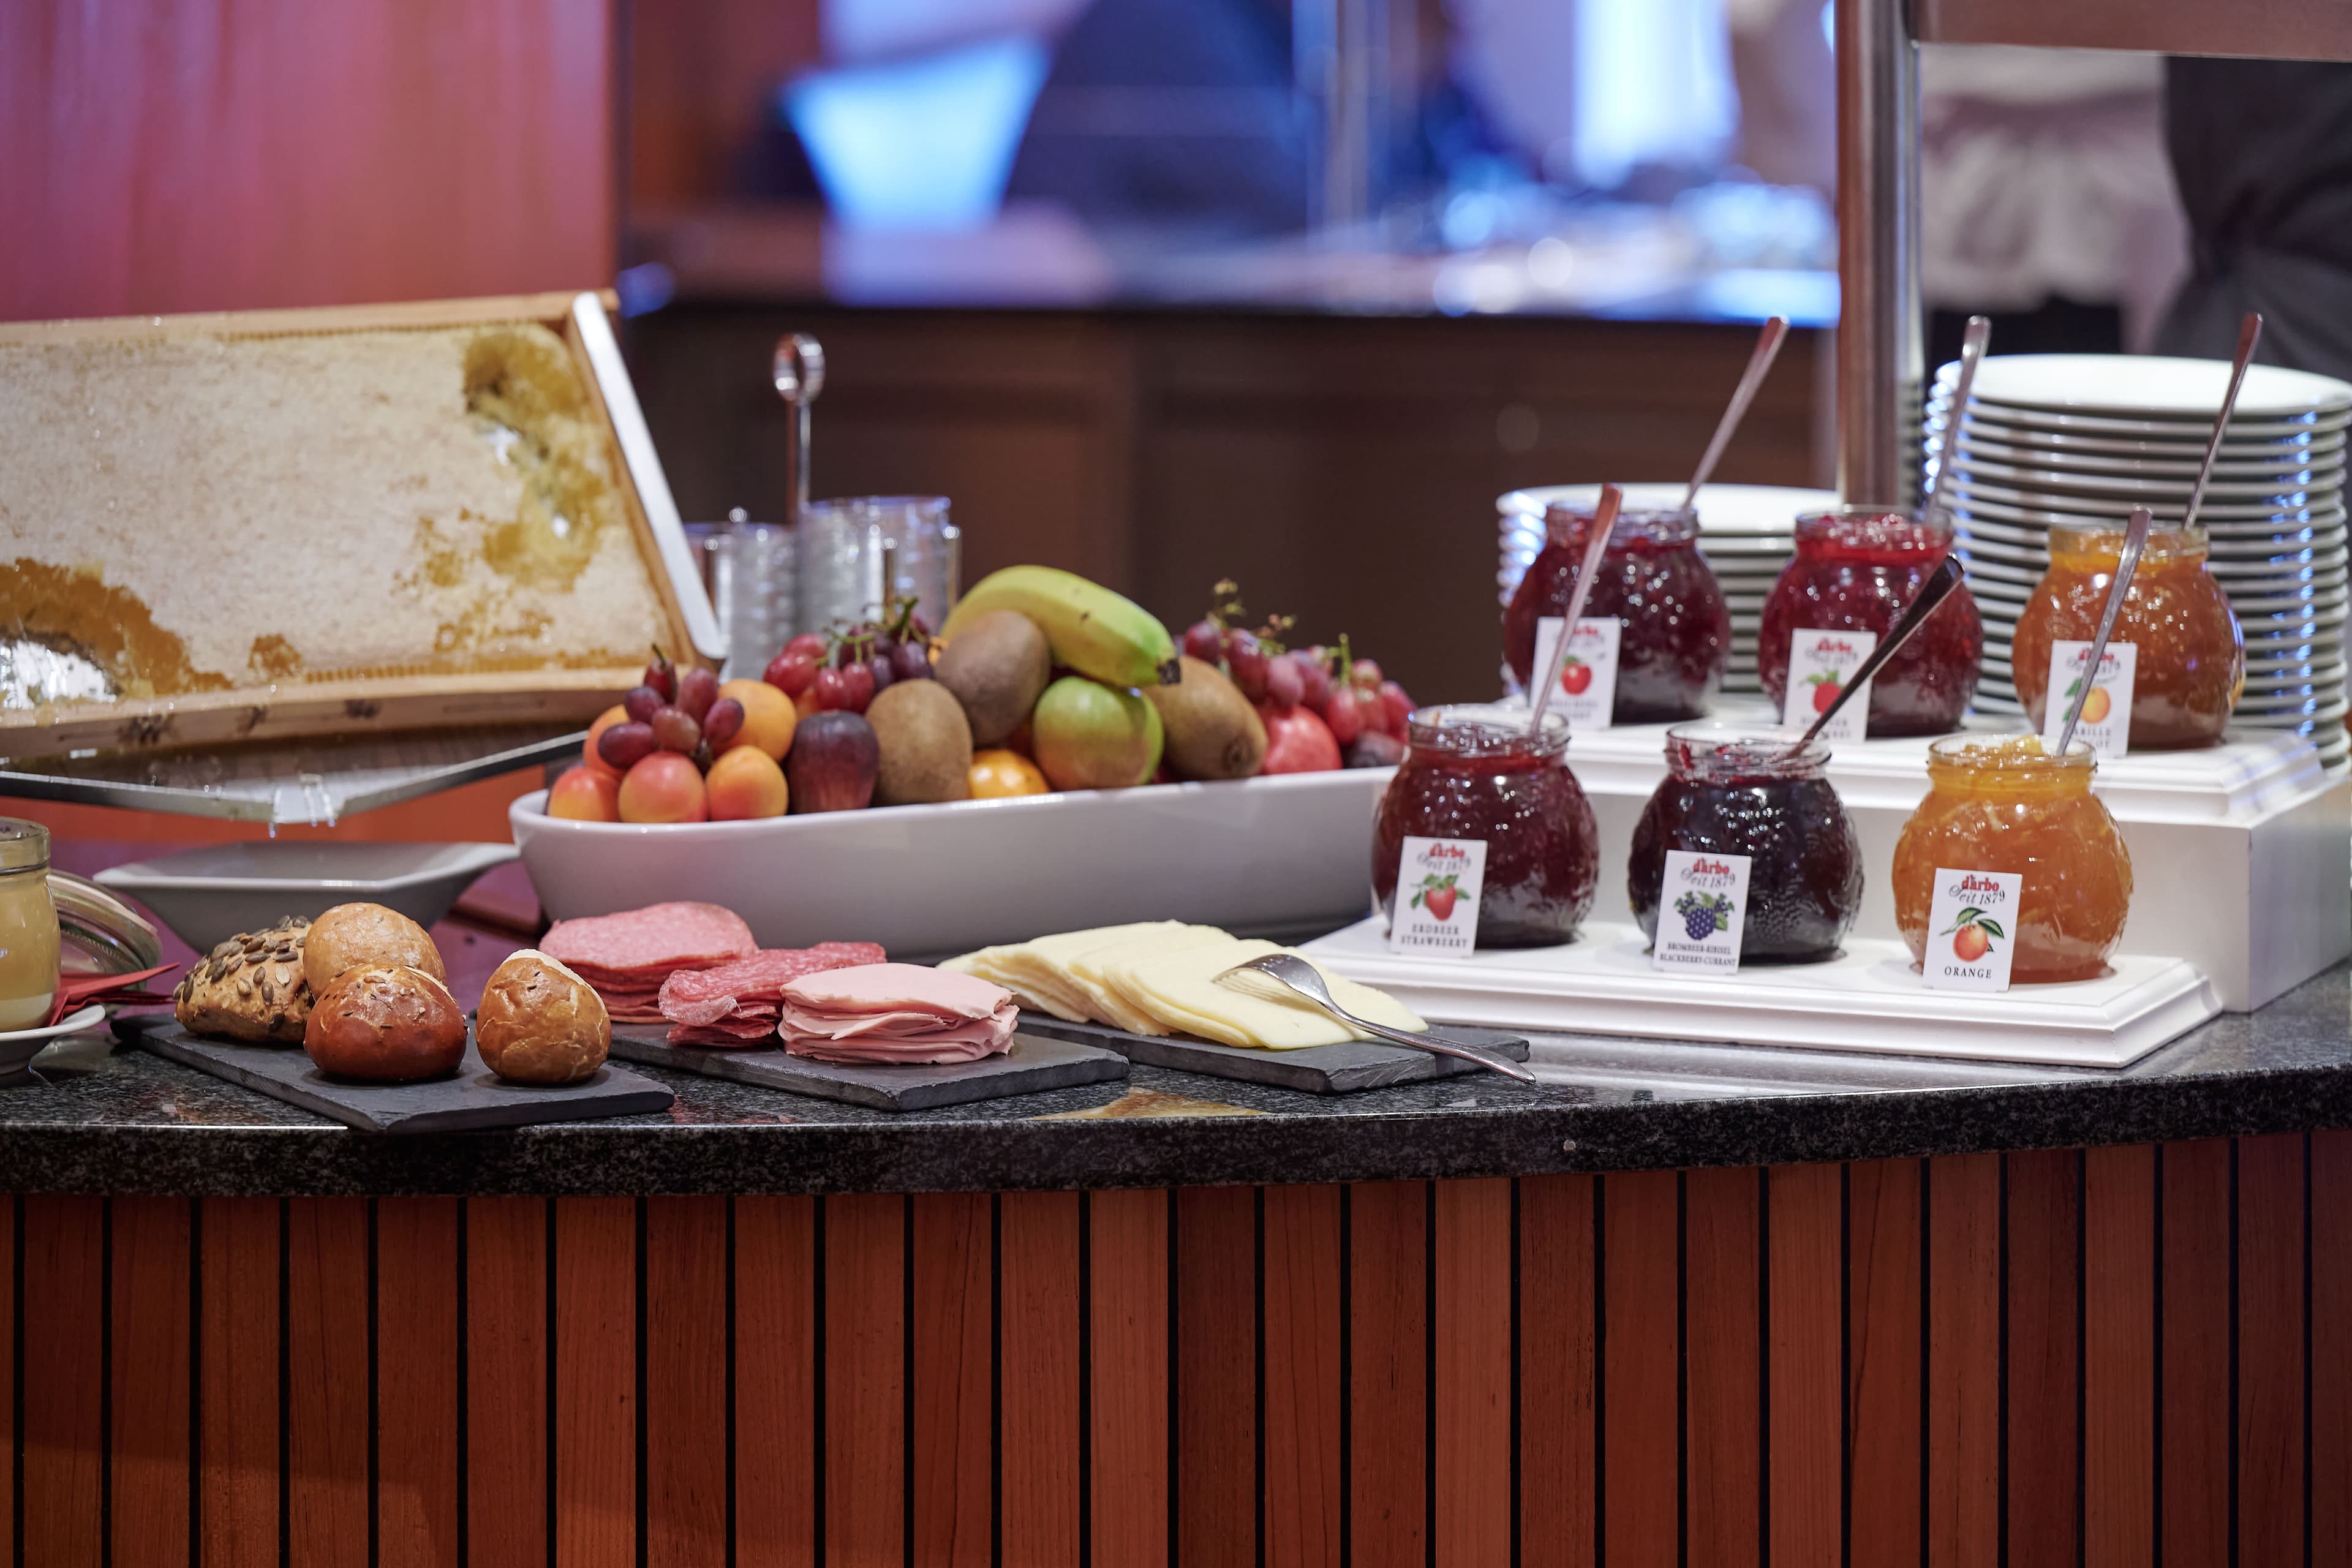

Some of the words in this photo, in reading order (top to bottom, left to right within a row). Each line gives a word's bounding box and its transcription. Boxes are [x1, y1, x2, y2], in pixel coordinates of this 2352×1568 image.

[1961, 875, 1999, 892] d'arbo
[1949, 885, 1976, 903] Seit
[1979, 891, 2005, 905] 1879
[1401, 935, 1468, 948] STRAWBERRY
[1944, 966, 1992, 979] ORANGE
